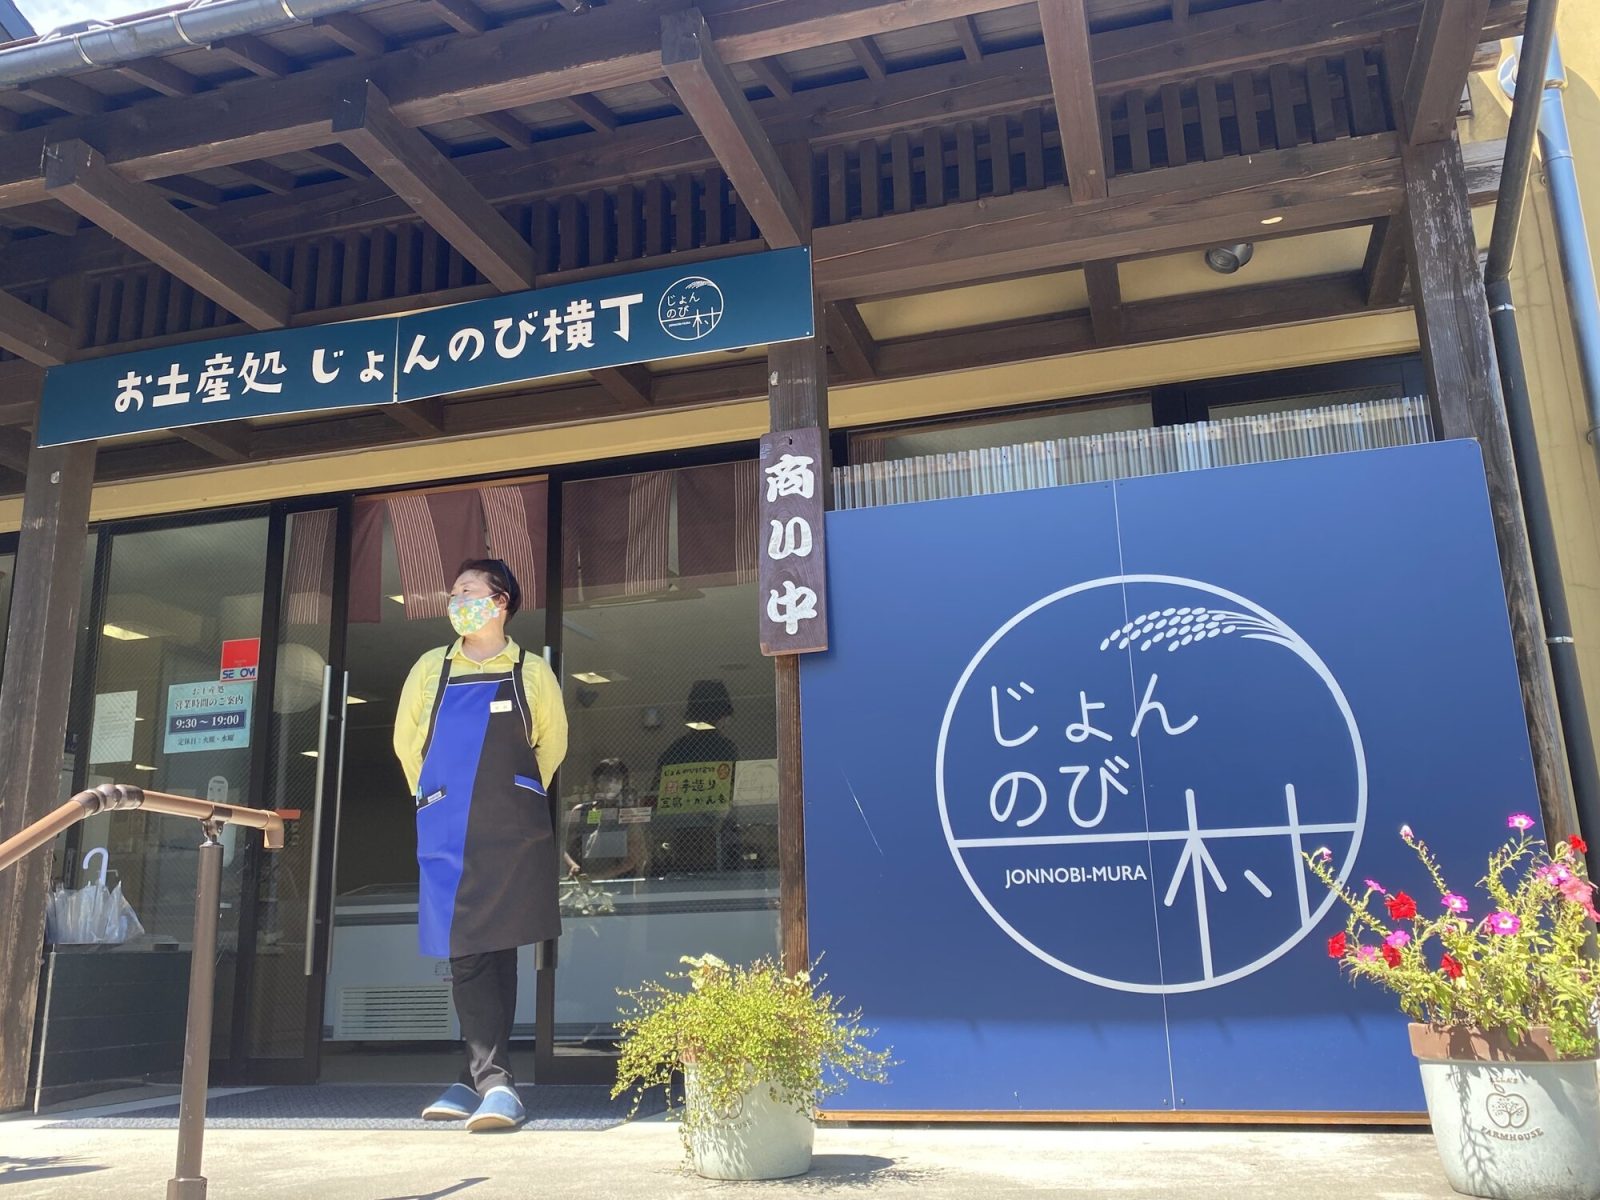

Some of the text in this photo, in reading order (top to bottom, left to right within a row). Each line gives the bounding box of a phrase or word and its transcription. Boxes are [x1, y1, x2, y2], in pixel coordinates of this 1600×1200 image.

[666, 305, 689, 319] のび
[667, 292, 700, 307] じょん
[114, 293, 645, 413] お土産処 じょんのび横丁
[765, 453, 818, 635] 商い中
[222, 667, 256, 679] SEOM
[175, 718, 197, 729] 9:30
[211, 714, 239, 727] 19:00
[990, 673, 1199, 748] じょん
[990, 755, 1130, 829] のび
[1005, 864, 1148, 889] JONNOBI-MURA
[1163, 783, 1312, 984] 村
[1481, 1125, 1545, 1141] FARMHOUSE
